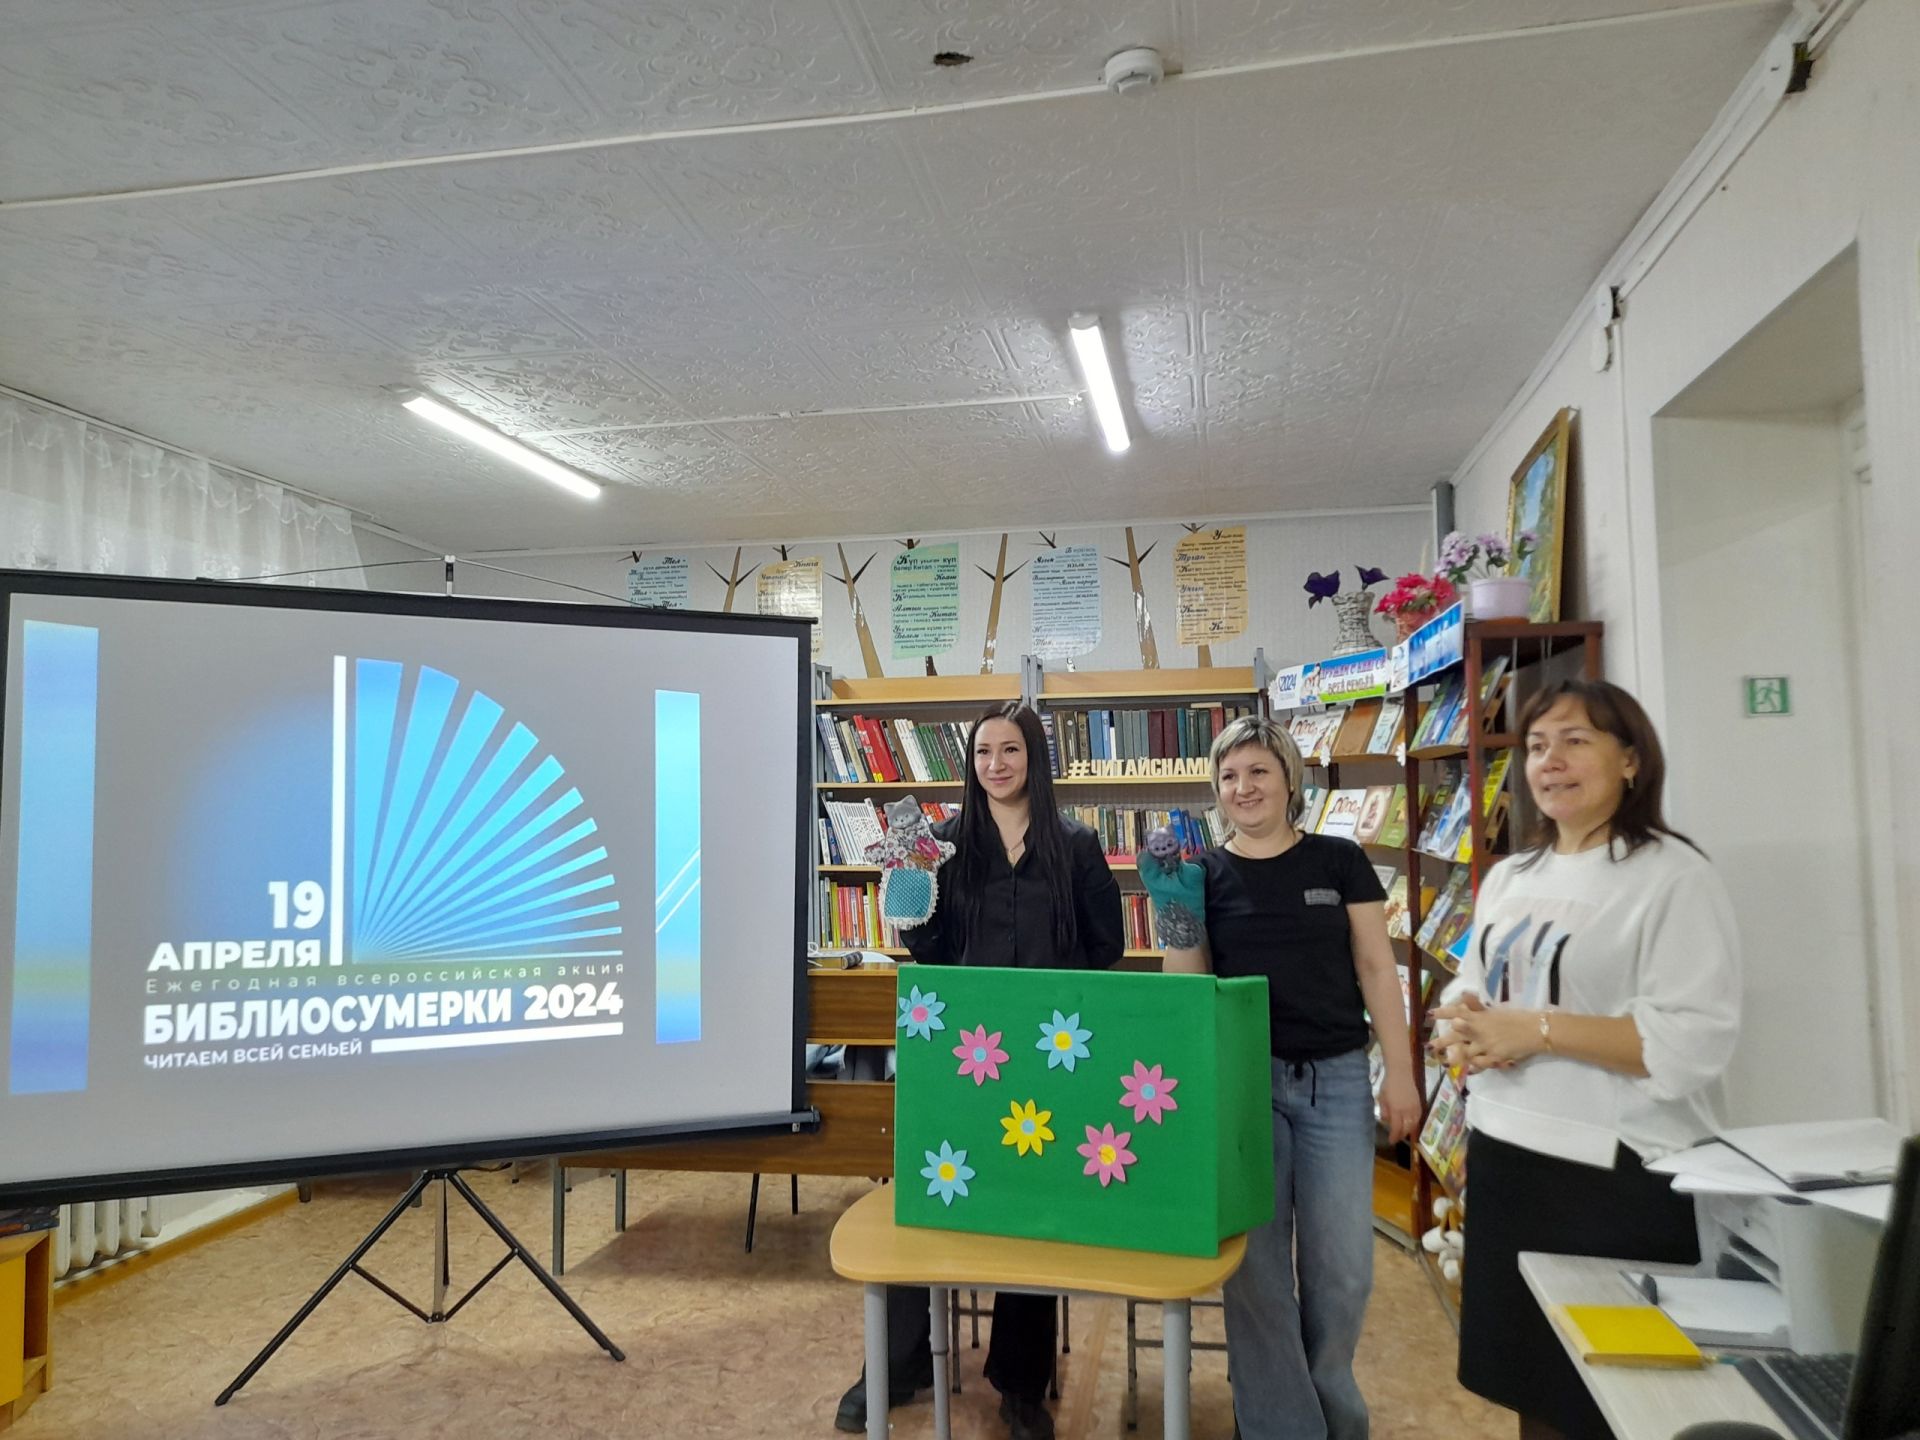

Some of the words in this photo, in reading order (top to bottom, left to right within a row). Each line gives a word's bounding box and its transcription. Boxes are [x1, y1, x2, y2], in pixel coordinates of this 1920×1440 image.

[268, 881, 325, 929] 19
[147, 940, 320, 972] АПРЕЛЯ
[146, 975, 318, 994] Ежегодная
[337, 966, 542, 986] всероссийская
[557, 962, 624, 978] акция
[143, 988, 513, 1045] БИБЛИОСУМЕРКИ
[523, 981, 624, 1022] 2024
[144, 1048, 228, 1071] ЧИТАЕМ
[233, 1044, 285, 1063] ВСЕЙ
